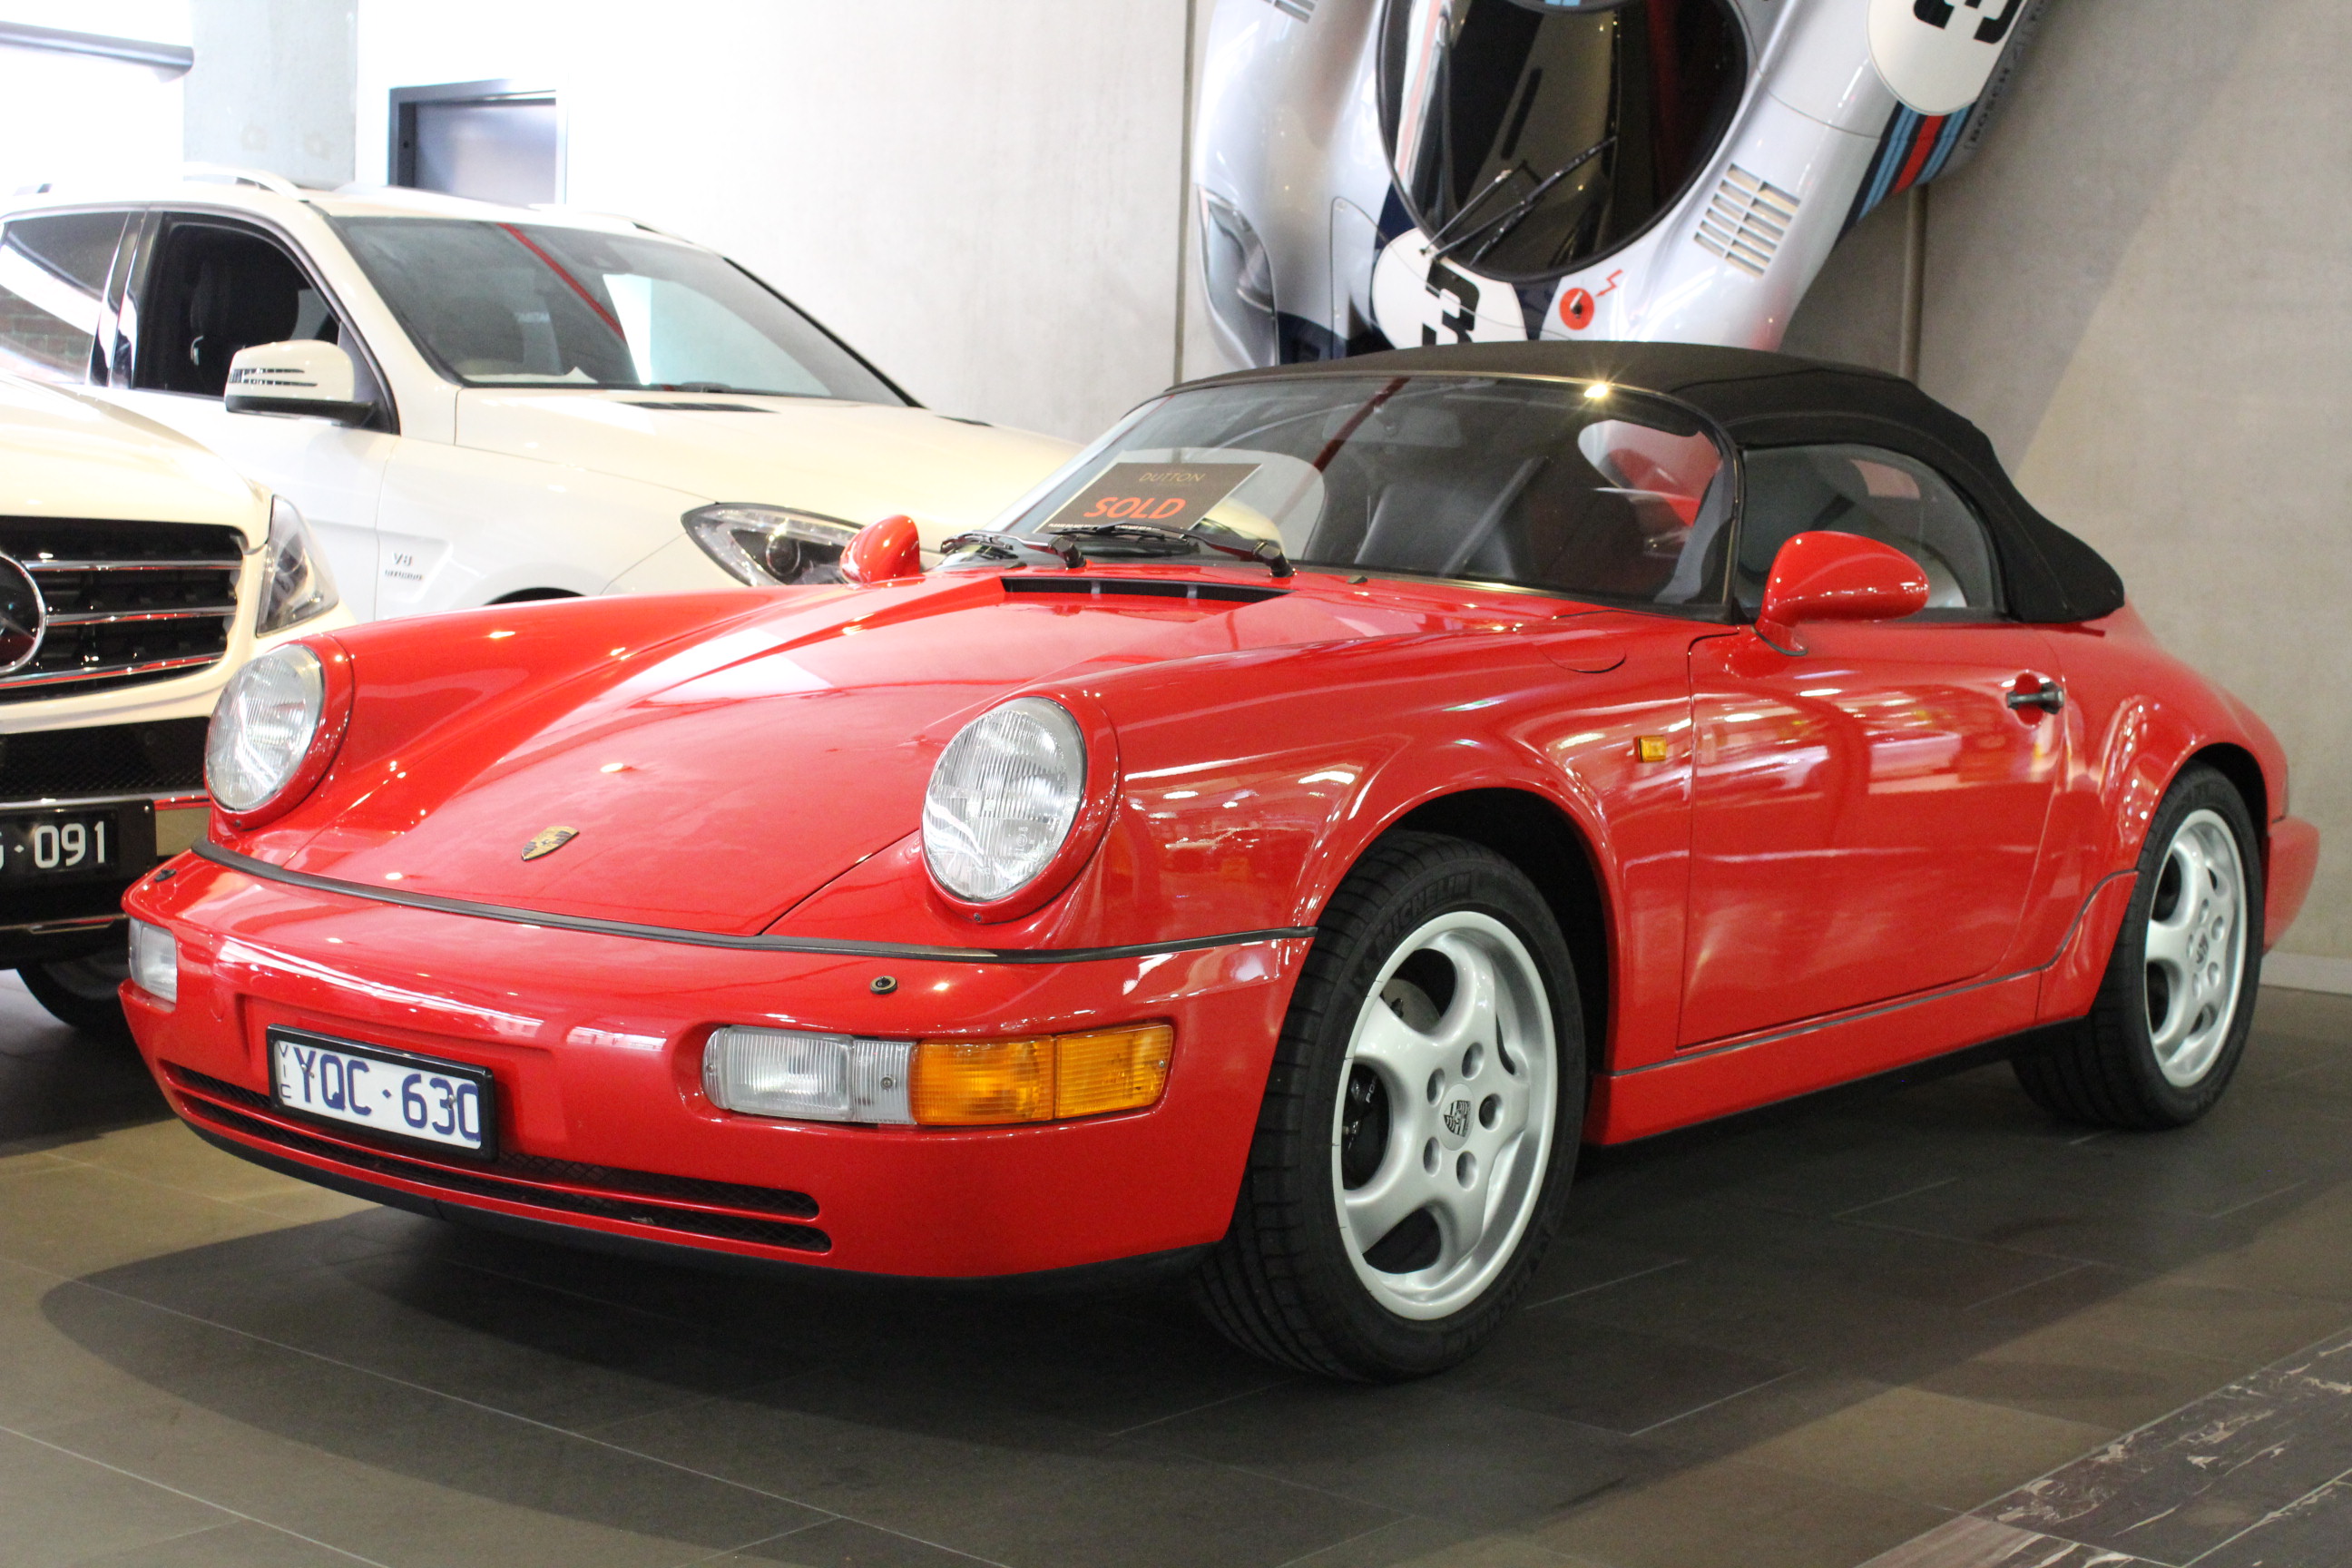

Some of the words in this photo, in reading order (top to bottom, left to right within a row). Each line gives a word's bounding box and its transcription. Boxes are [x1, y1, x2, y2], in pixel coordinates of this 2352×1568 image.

[1138, 472, 1206, 483] DUTTON
[1083, 496, 1186, 519] SOLD
[34, 820, 105, 868] 091
[1372, 871, 1473, 962] MICHELIN
[279, 1044, 292, 1099] VIC
[293, 1046, 372, 1117] YQC
[401, 1073, 482, 1142] 630
